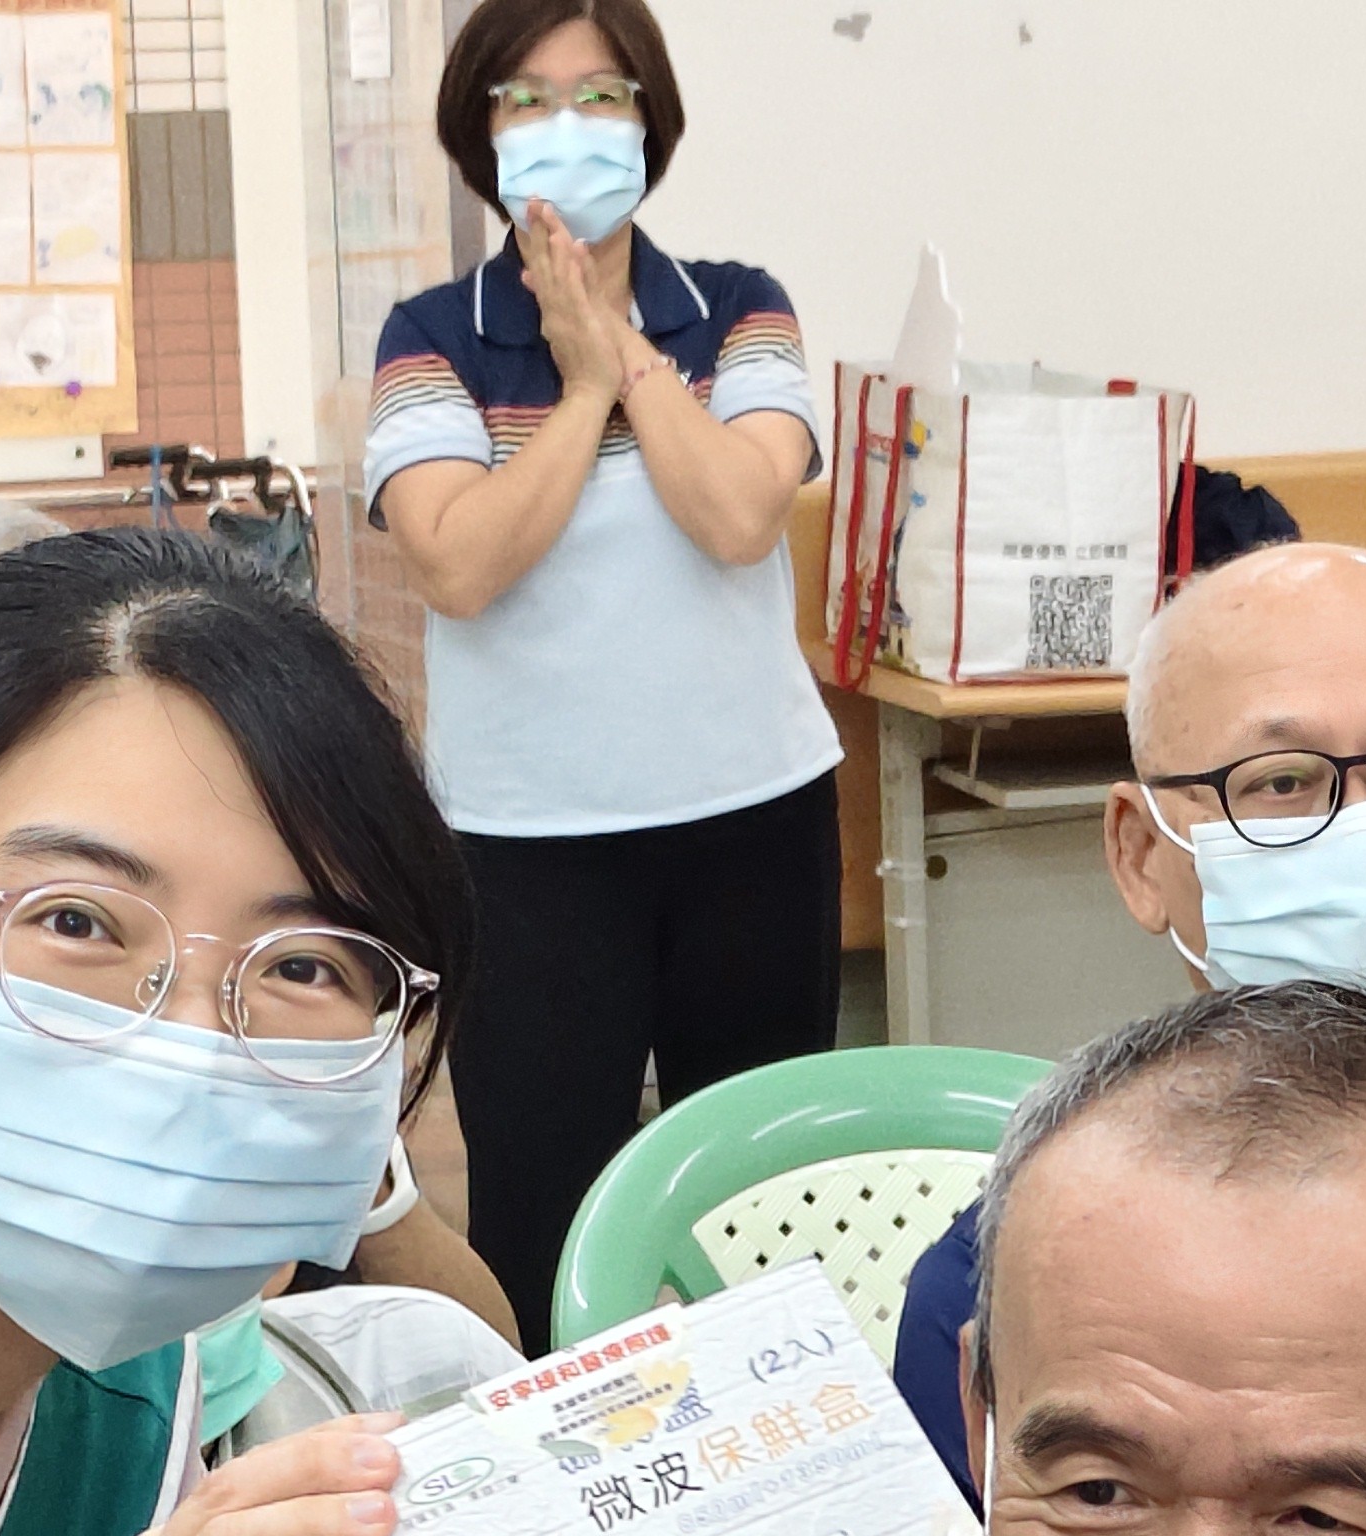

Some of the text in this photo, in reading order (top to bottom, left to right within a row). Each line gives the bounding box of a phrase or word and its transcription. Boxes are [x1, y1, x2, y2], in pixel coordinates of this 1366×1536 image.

[580, 1382, 875, 1532] 微波保鮮盒
